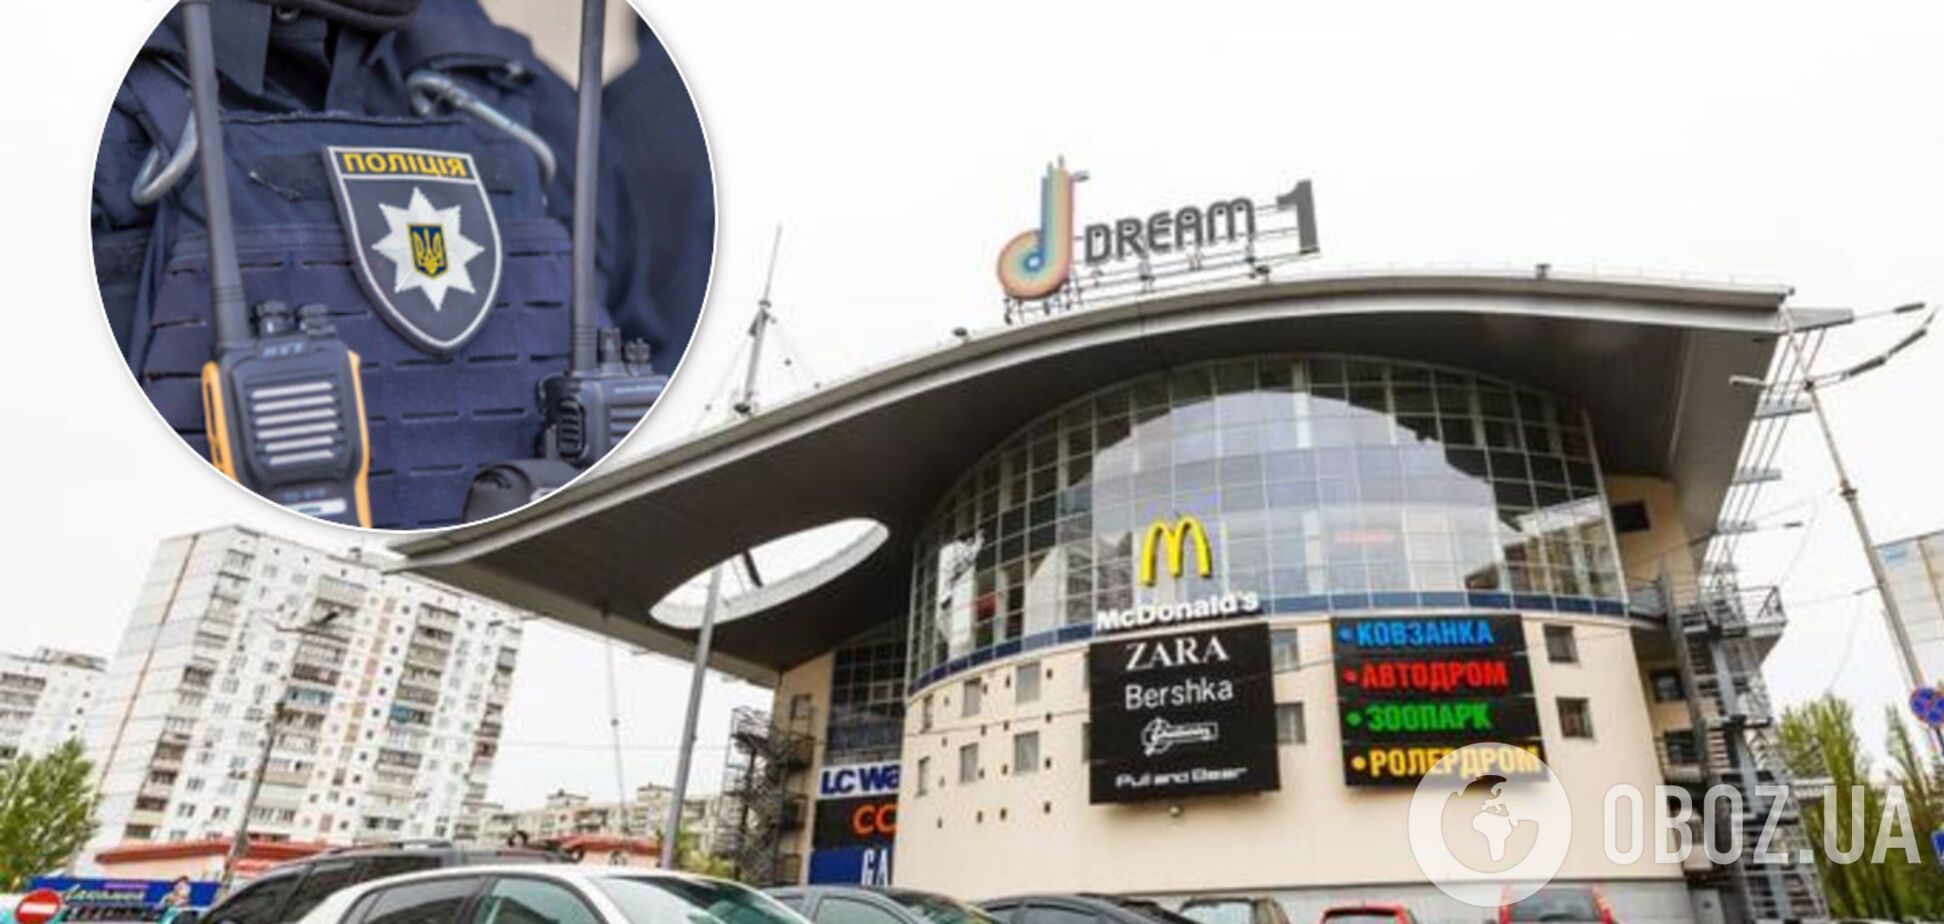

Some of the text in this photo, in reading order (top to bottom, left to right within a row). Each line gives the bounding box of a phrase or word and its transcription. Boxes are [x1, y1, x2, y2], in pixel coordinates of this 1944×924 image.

[343, 152, 468, 177] ПОЛІЦІЯ
[1083, 197, 1256, 266] DREAM
[1275, 178, 1320, 255] 1
[1096, 591, 1259, 631] McDonald's
[1356, 620, 1494, 647] КОВЗАНКА
[1125, 635, 1230, 672] ZARA
[1360, 661, 1509, 692] АВТОДРОМ
[1124, 677, 1234, 711] Bershka
[1365, 702, 1492, 732] ЗООПАРК
[1154, 770, 1189, 787] and
[1191, 766, 1248, 784] Bear
[1369, 747, 1544, 779] РОЛЕРДРОМ
[820, 769, 855, 795] LC
